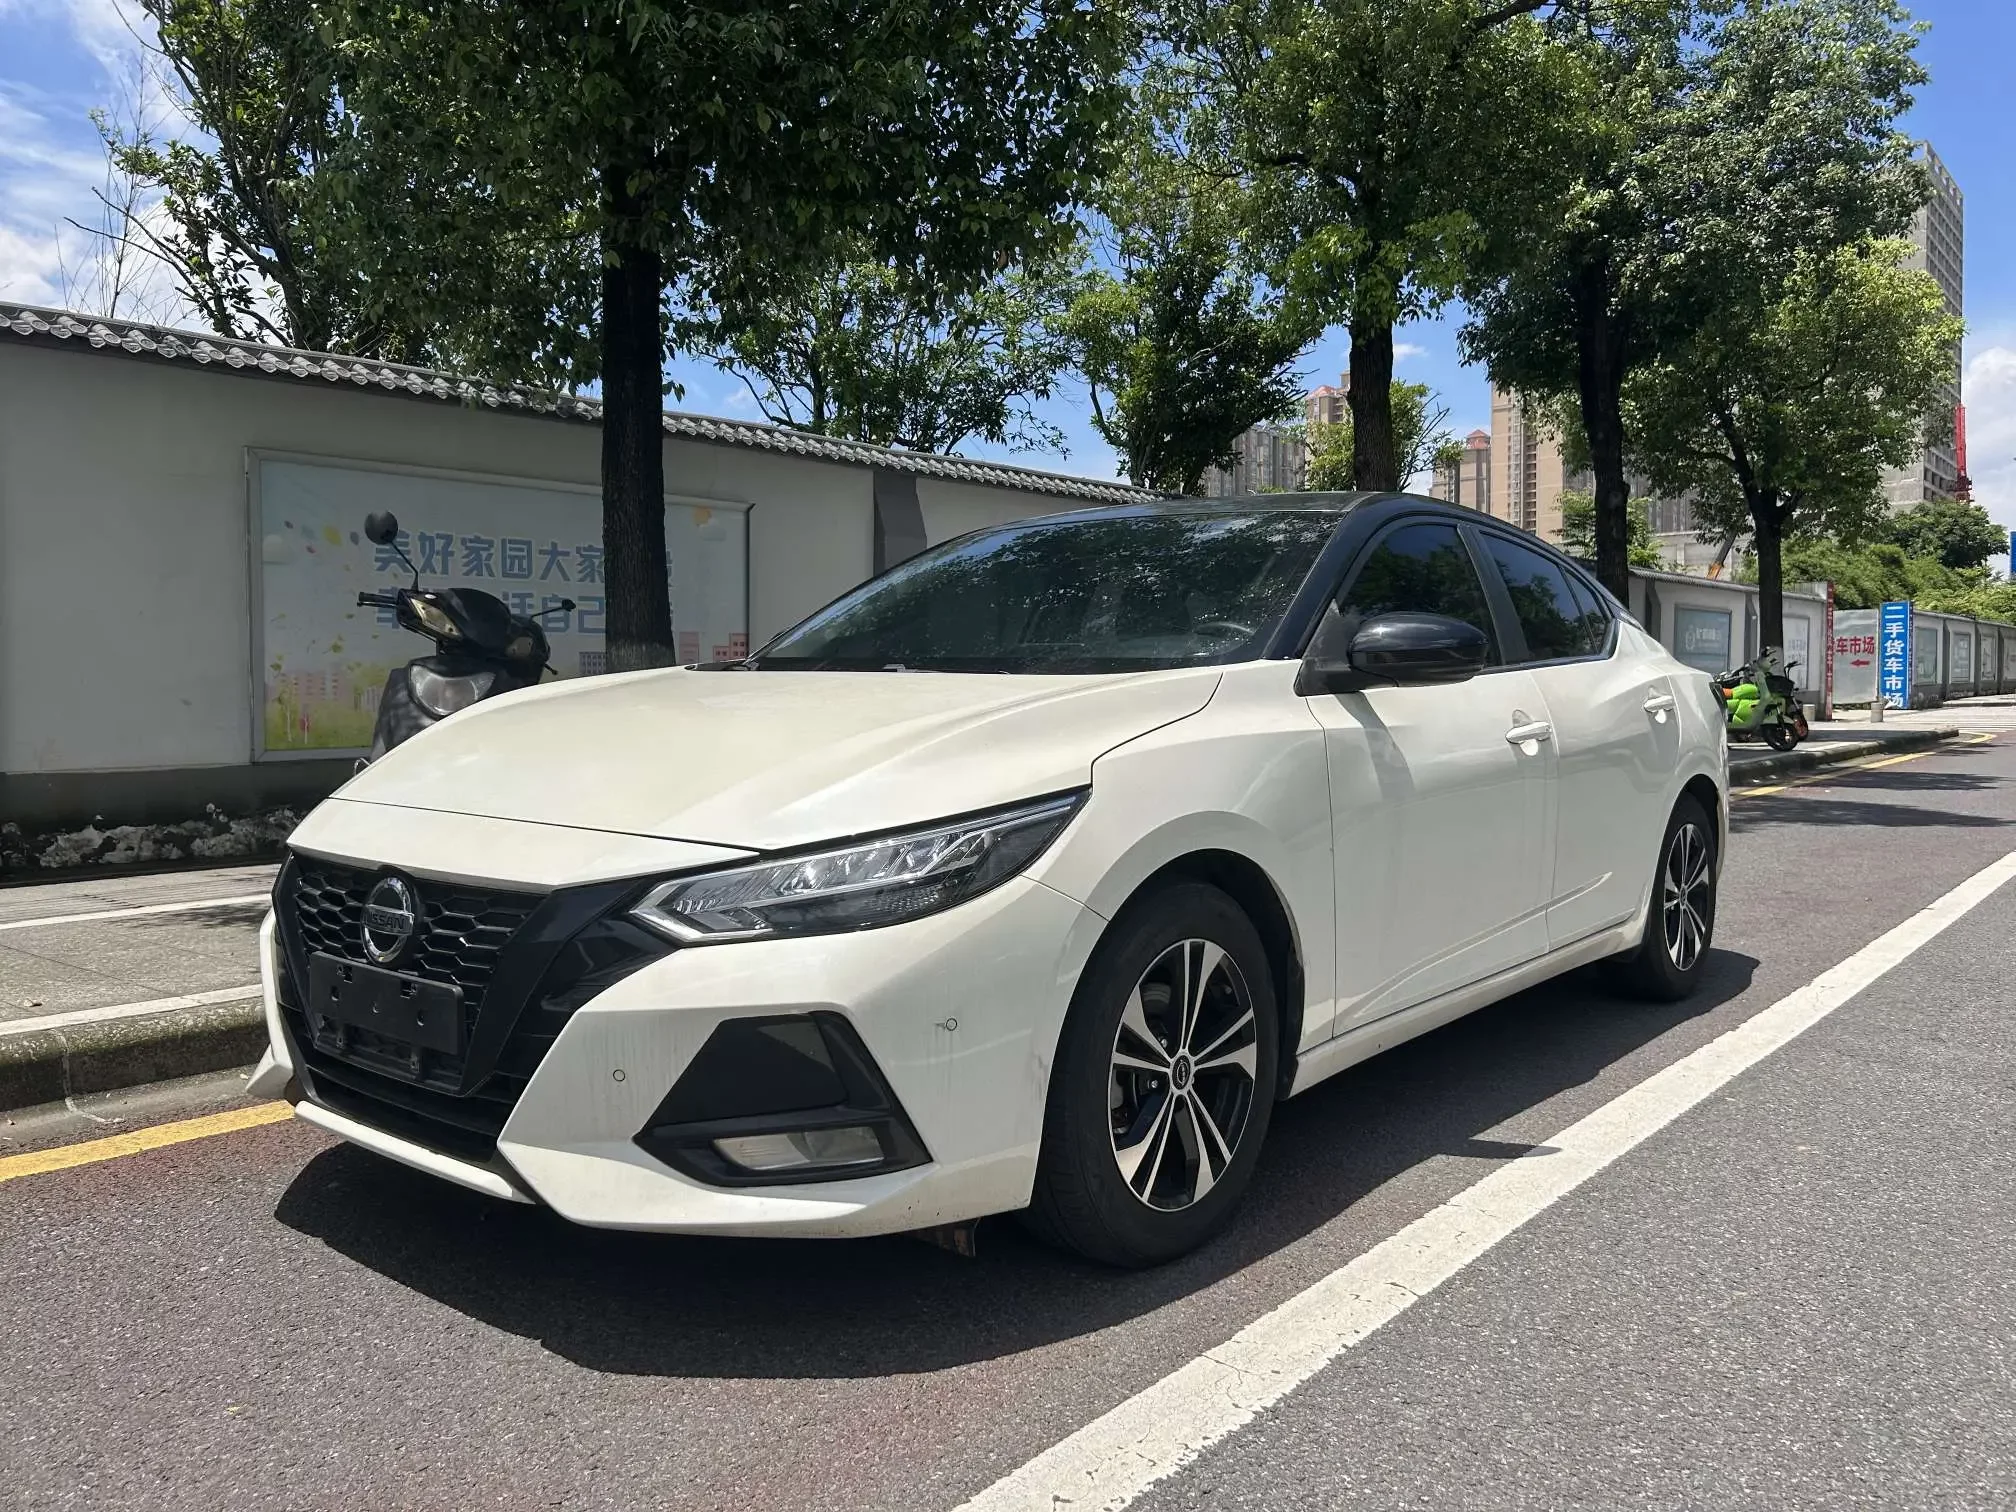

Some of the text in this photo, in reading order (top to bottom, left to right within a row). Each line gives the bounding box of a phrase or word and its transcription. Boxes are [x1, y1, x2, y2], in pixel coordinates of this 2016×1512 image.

[374, 530, 673, 588] 美好家园大家
[1833, 636, 1875, 655] 车市场
[1884, 605, 1905, 708] 二手货车市场
[362, 909, 405, 930] NISSAN
